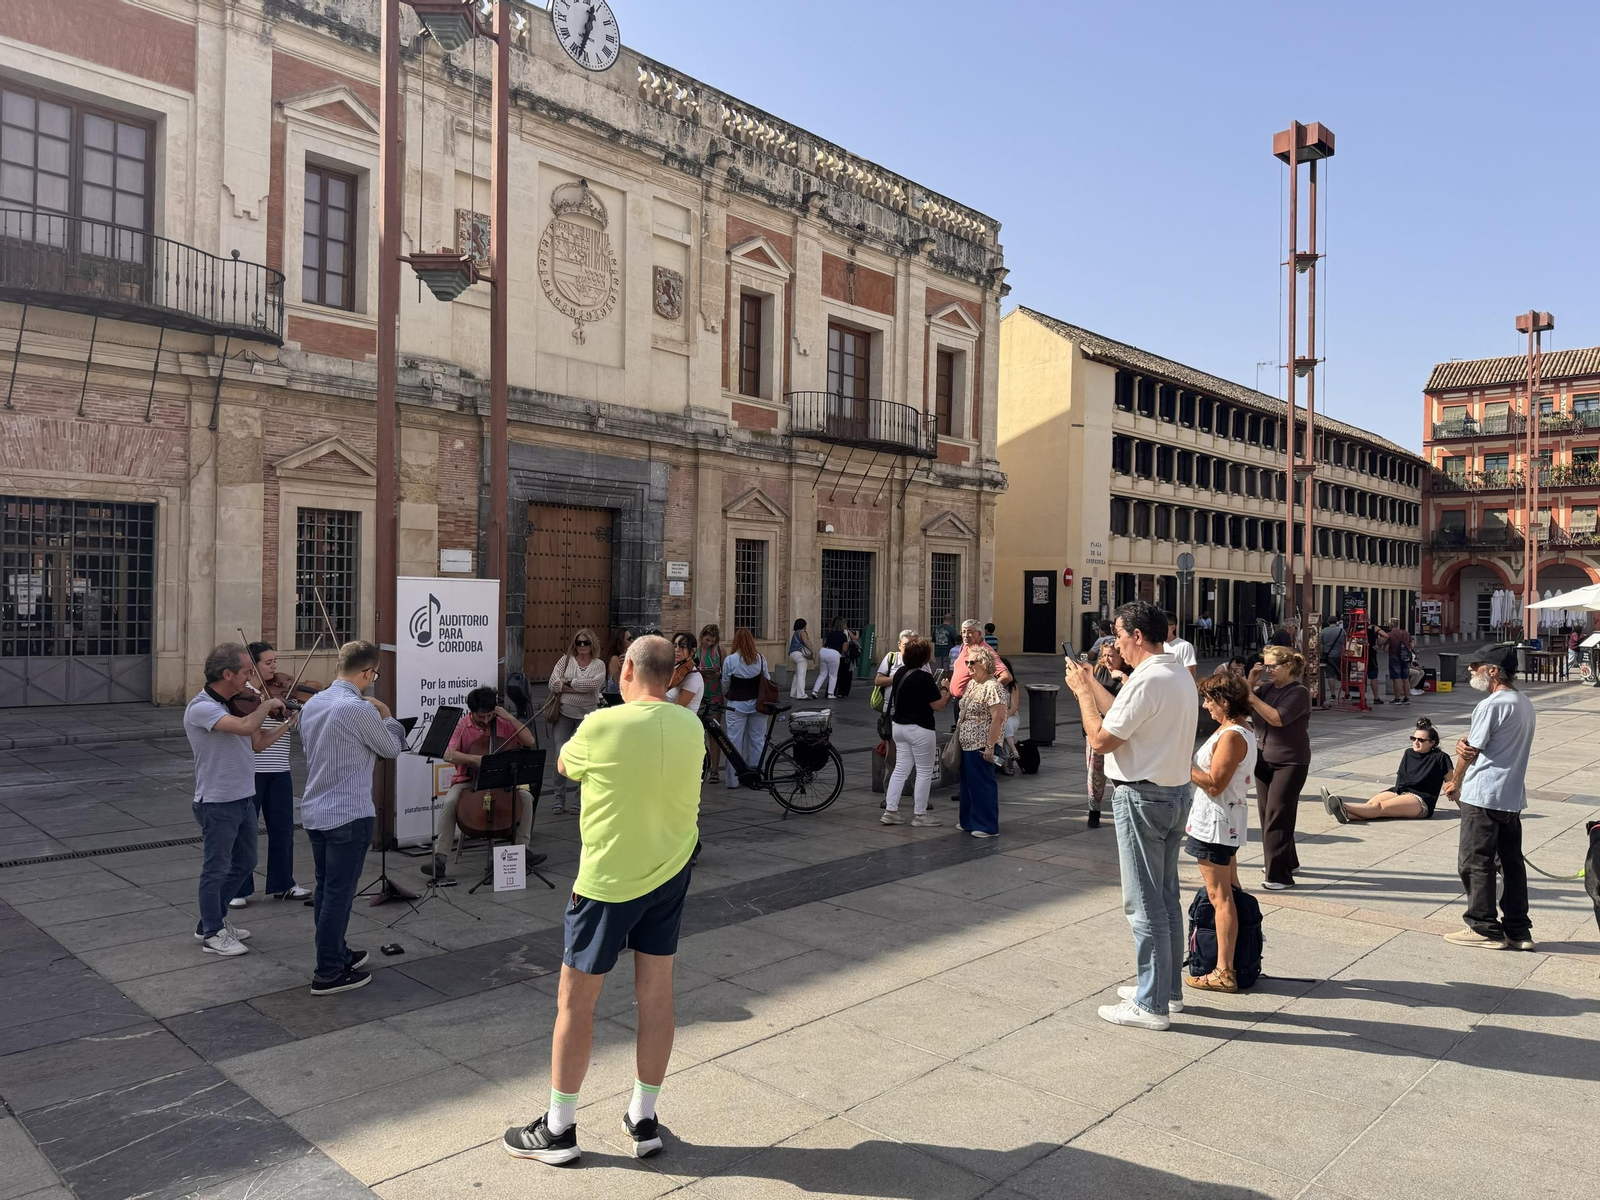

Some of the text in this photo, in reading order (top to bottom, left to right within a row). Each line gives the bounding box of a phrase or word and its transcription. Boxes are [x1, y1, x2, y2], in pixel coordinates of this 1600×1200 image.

[439, 614, 489, 627] AUDITORIO
[439, 627, 464, 640] PARA
[438, 639, 484, 653] CÓRDOBA
[420, 677, 478, 690] Por la música
[420, 695, 436, 707] Por
[438, 695, 446, 706] la
